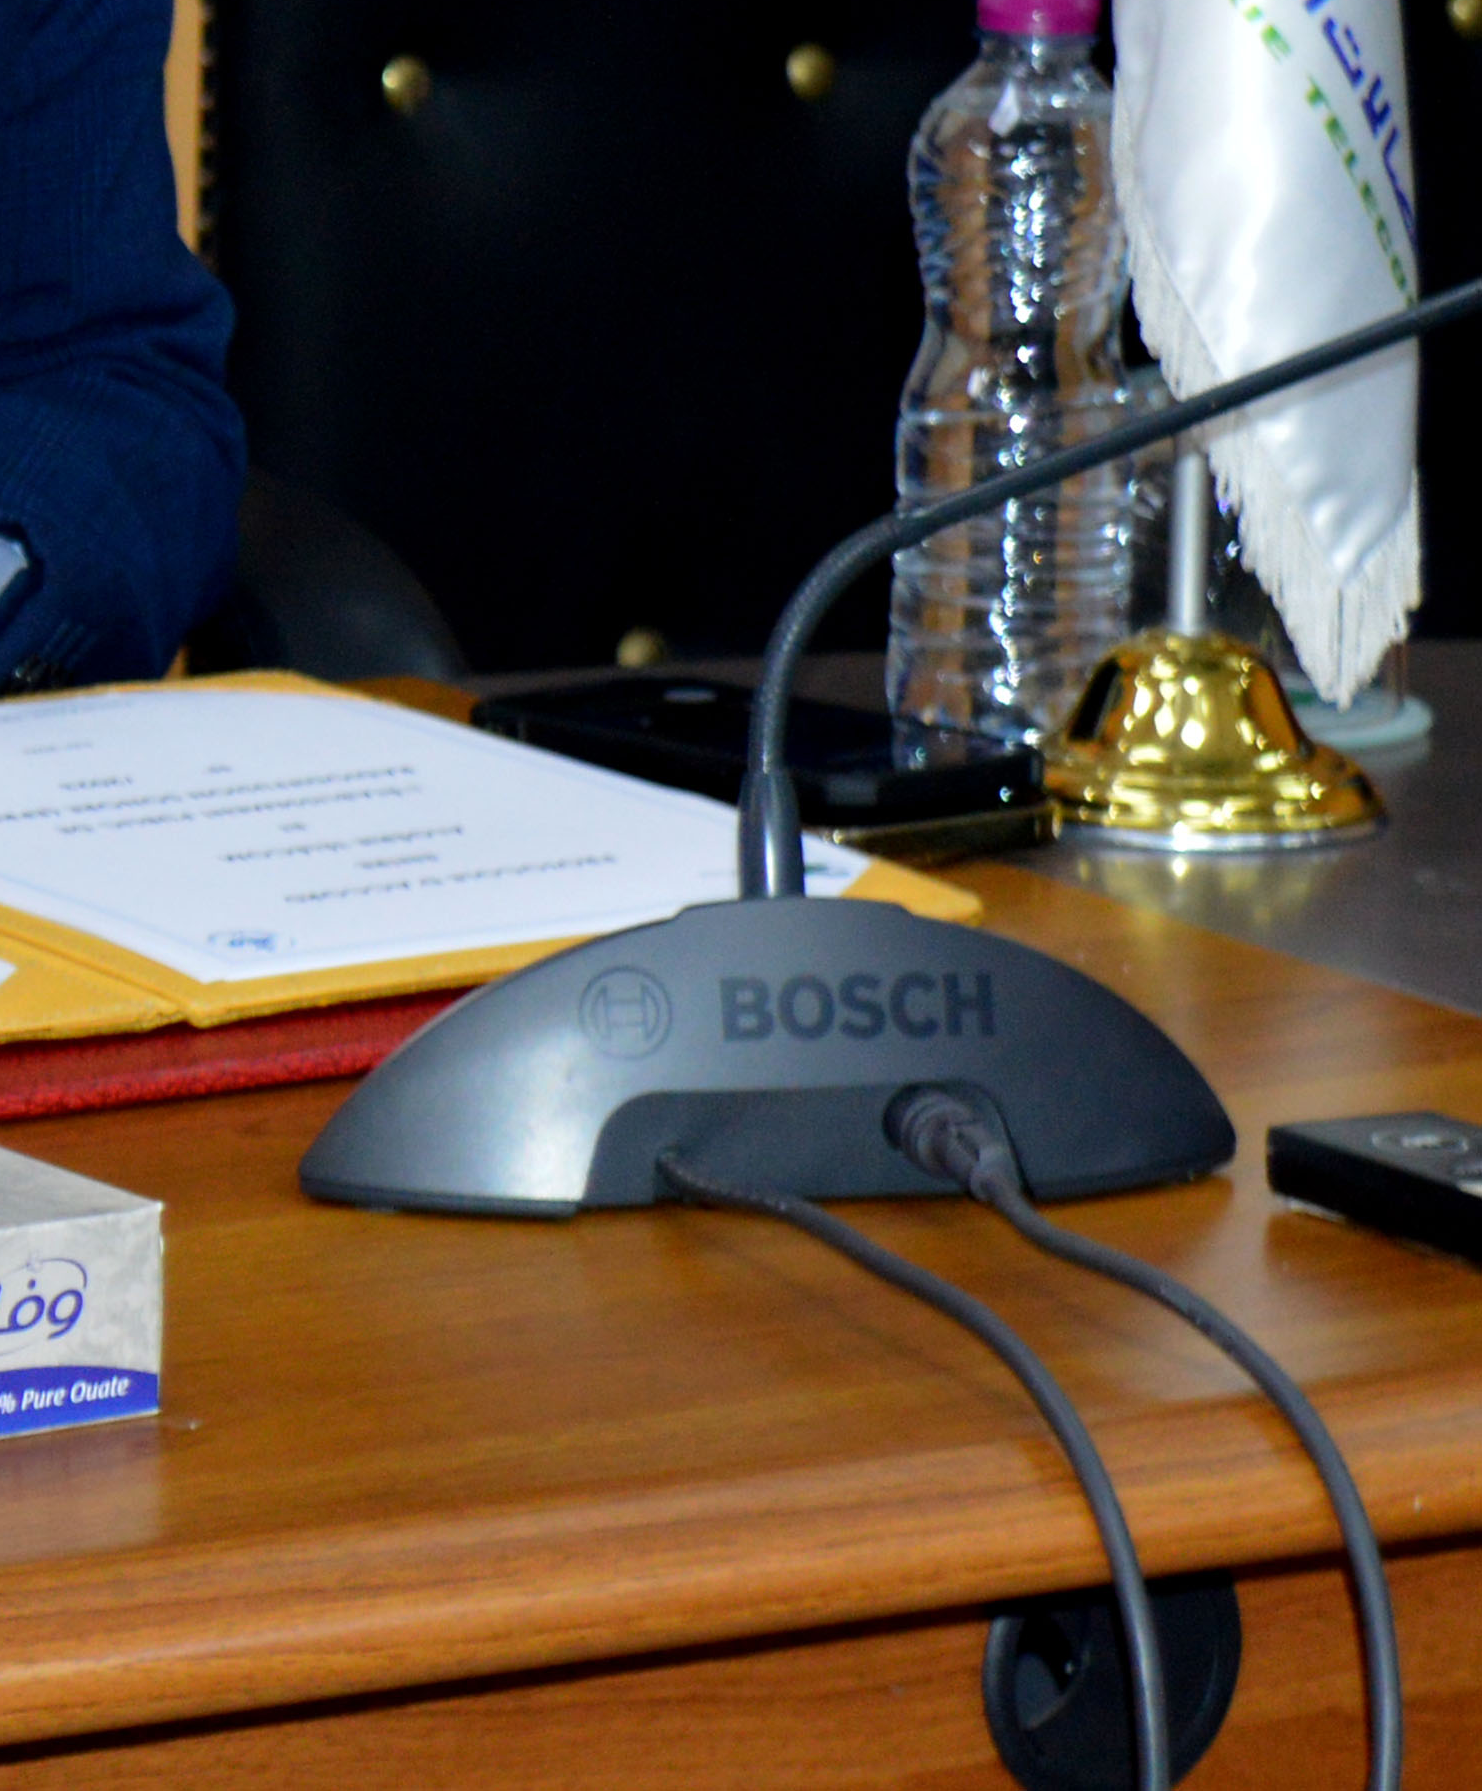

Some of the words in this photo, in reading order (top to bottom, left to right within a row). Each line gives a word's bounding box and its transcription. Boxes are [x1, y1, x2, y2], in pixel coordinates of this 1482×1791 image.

[719, 970, 995, 1043] BOSCH
[21, 1387, 65, 1411] Pure
[70, 1375, 131, 1404] Ouate
